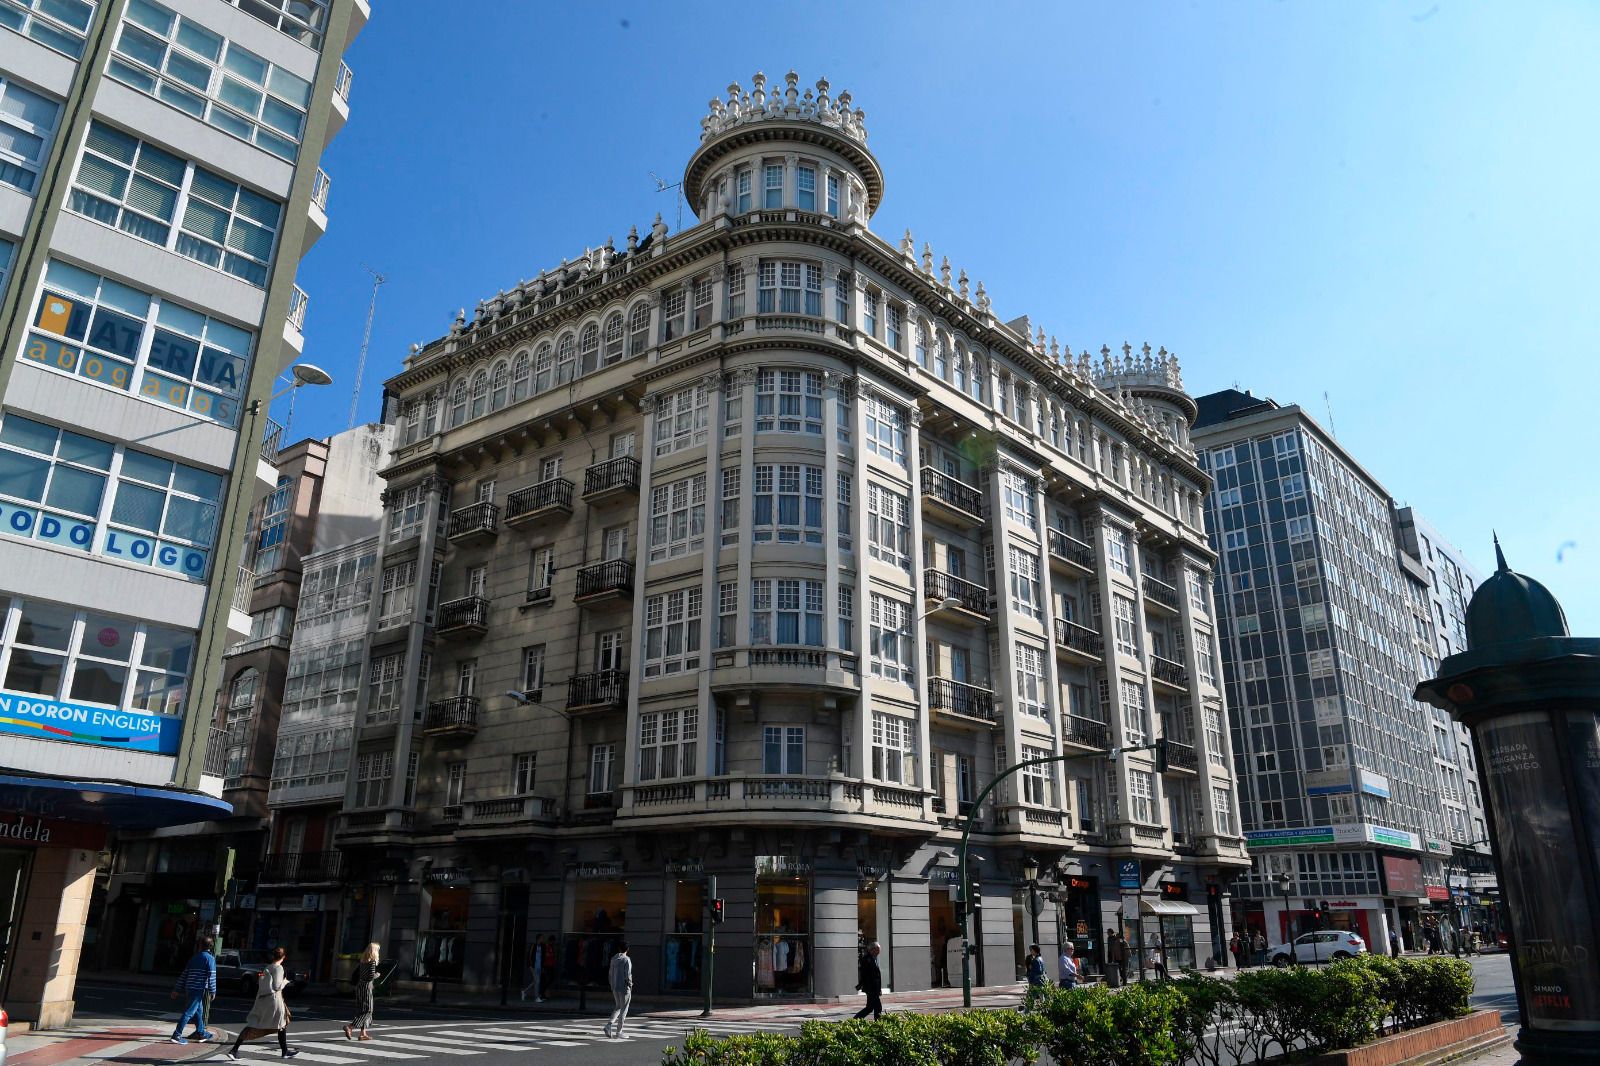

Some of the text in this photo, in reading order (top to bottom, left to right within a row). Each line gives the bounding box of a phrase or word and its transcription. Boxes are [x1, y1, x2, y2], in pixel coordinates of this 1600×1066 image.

[67, 308, 237, 390] LATERNA
[28, 339, 230, 420] abogados
[0, 506, 204, 572] ODÓLOGO
[17, 701, 88, 723] DORON
[92, 711, 162, 734] ENGLISH
[0, 816, 50, 843] ndela
[1541, 985, 1562, 993] MAYO
